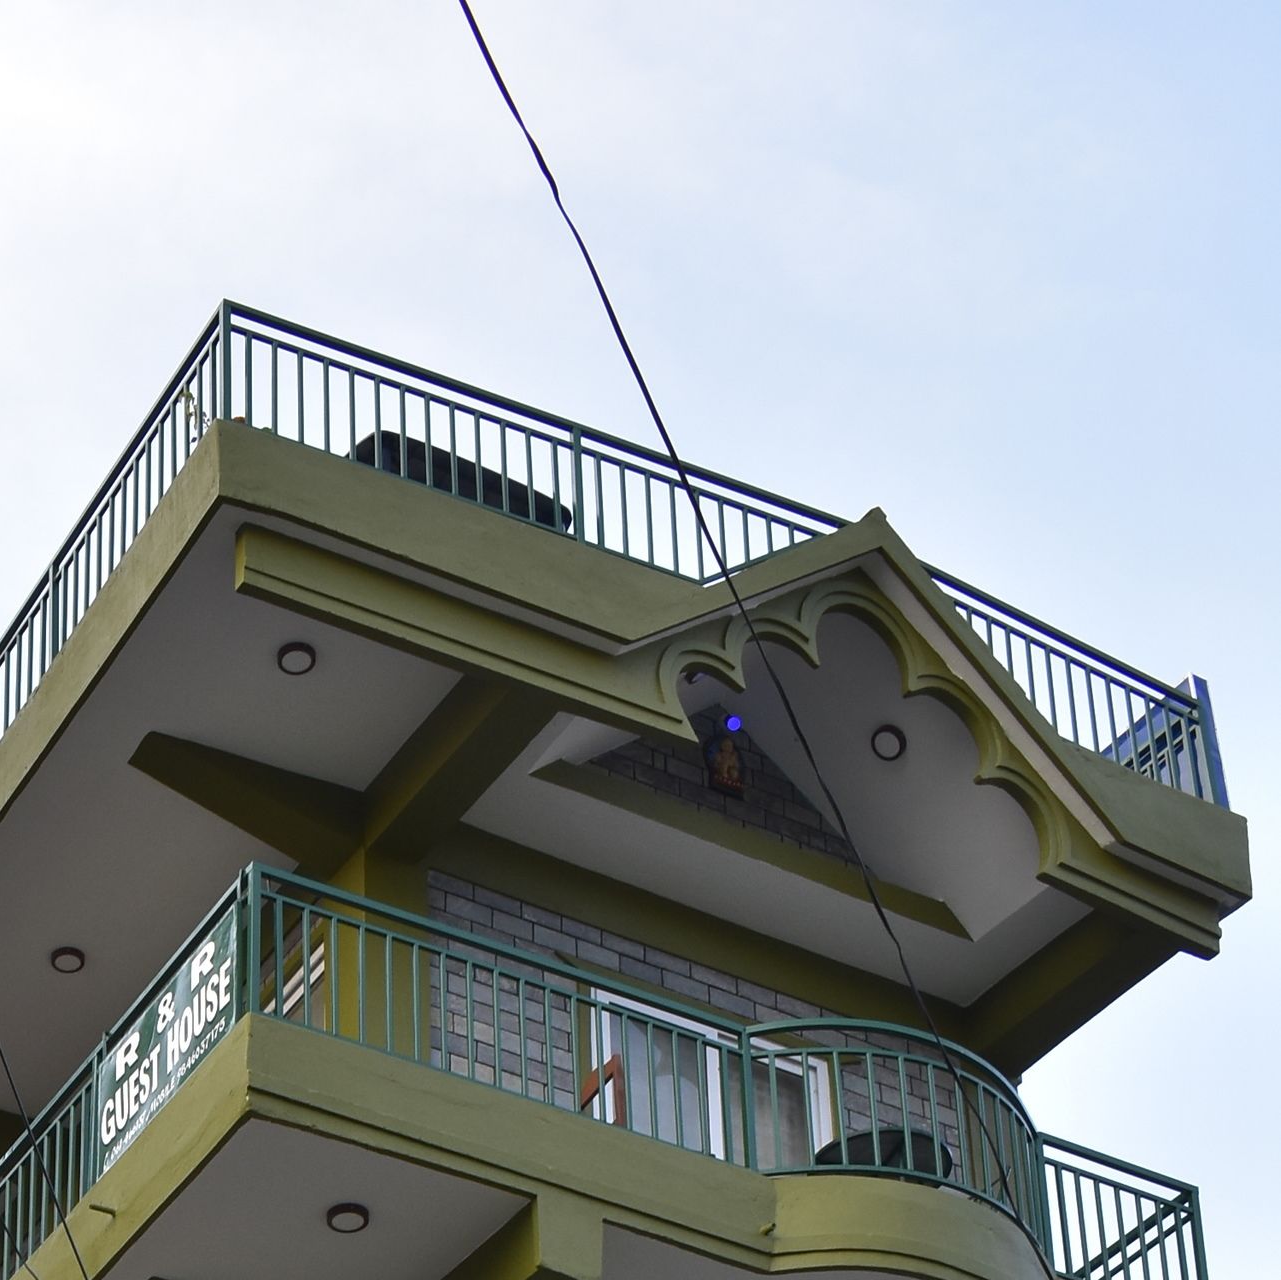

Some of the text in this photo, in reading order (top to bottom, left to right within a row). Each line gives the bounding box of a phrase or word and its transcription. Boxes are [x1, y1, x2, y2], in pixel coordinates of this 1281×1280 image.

[101, 957, 232, 1146] GUEST HOUSE
[116, 941, 216, 1081] R & R
